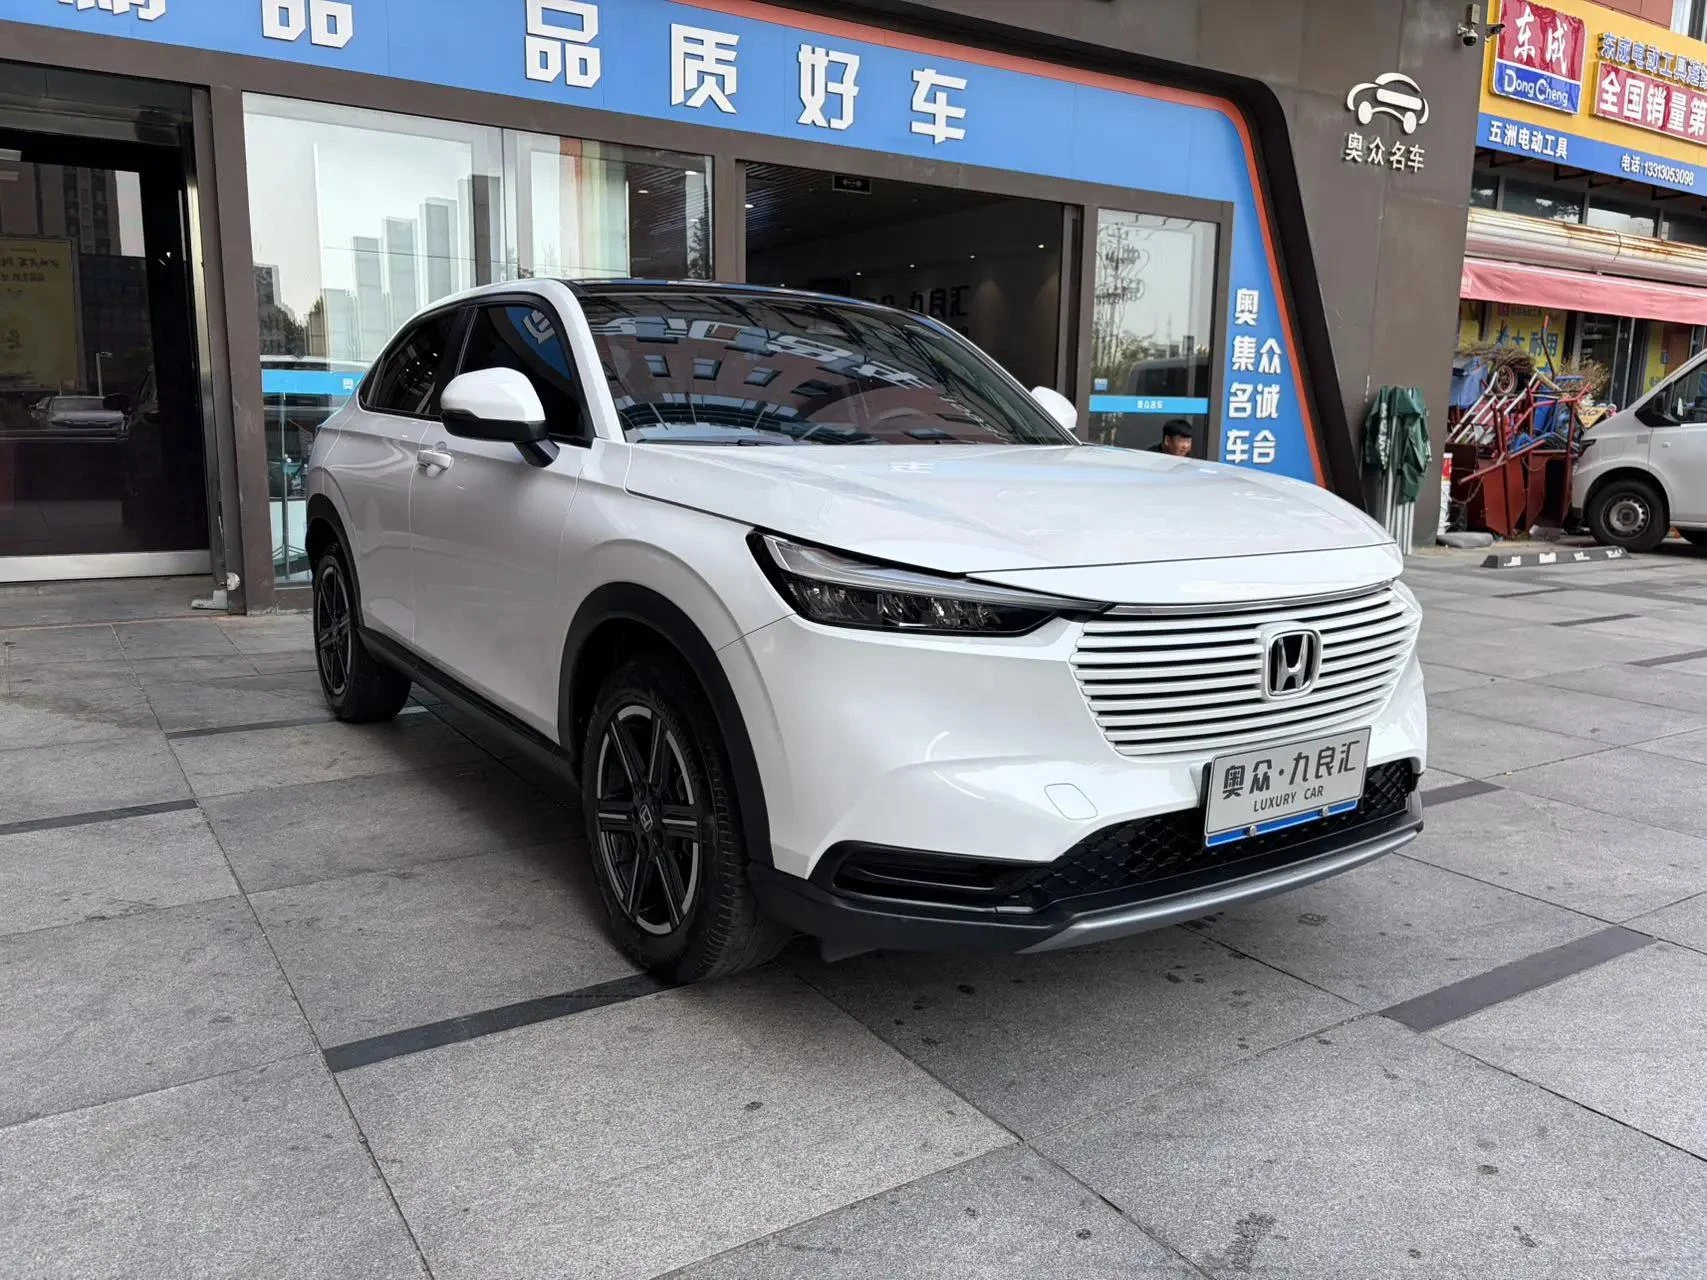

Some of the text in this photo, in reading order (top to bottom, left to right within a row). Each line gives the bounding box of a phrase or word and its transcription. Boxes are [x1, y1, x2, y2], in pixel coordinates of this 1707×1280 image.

[1512, 5, 1569, 75] 东成
[1344, 131, 1426, 174] 奥众名车
[1487, 119, 1569, 161] 五洲电动工具
[1252, 785, 1325, 812] LUXURY CAR
